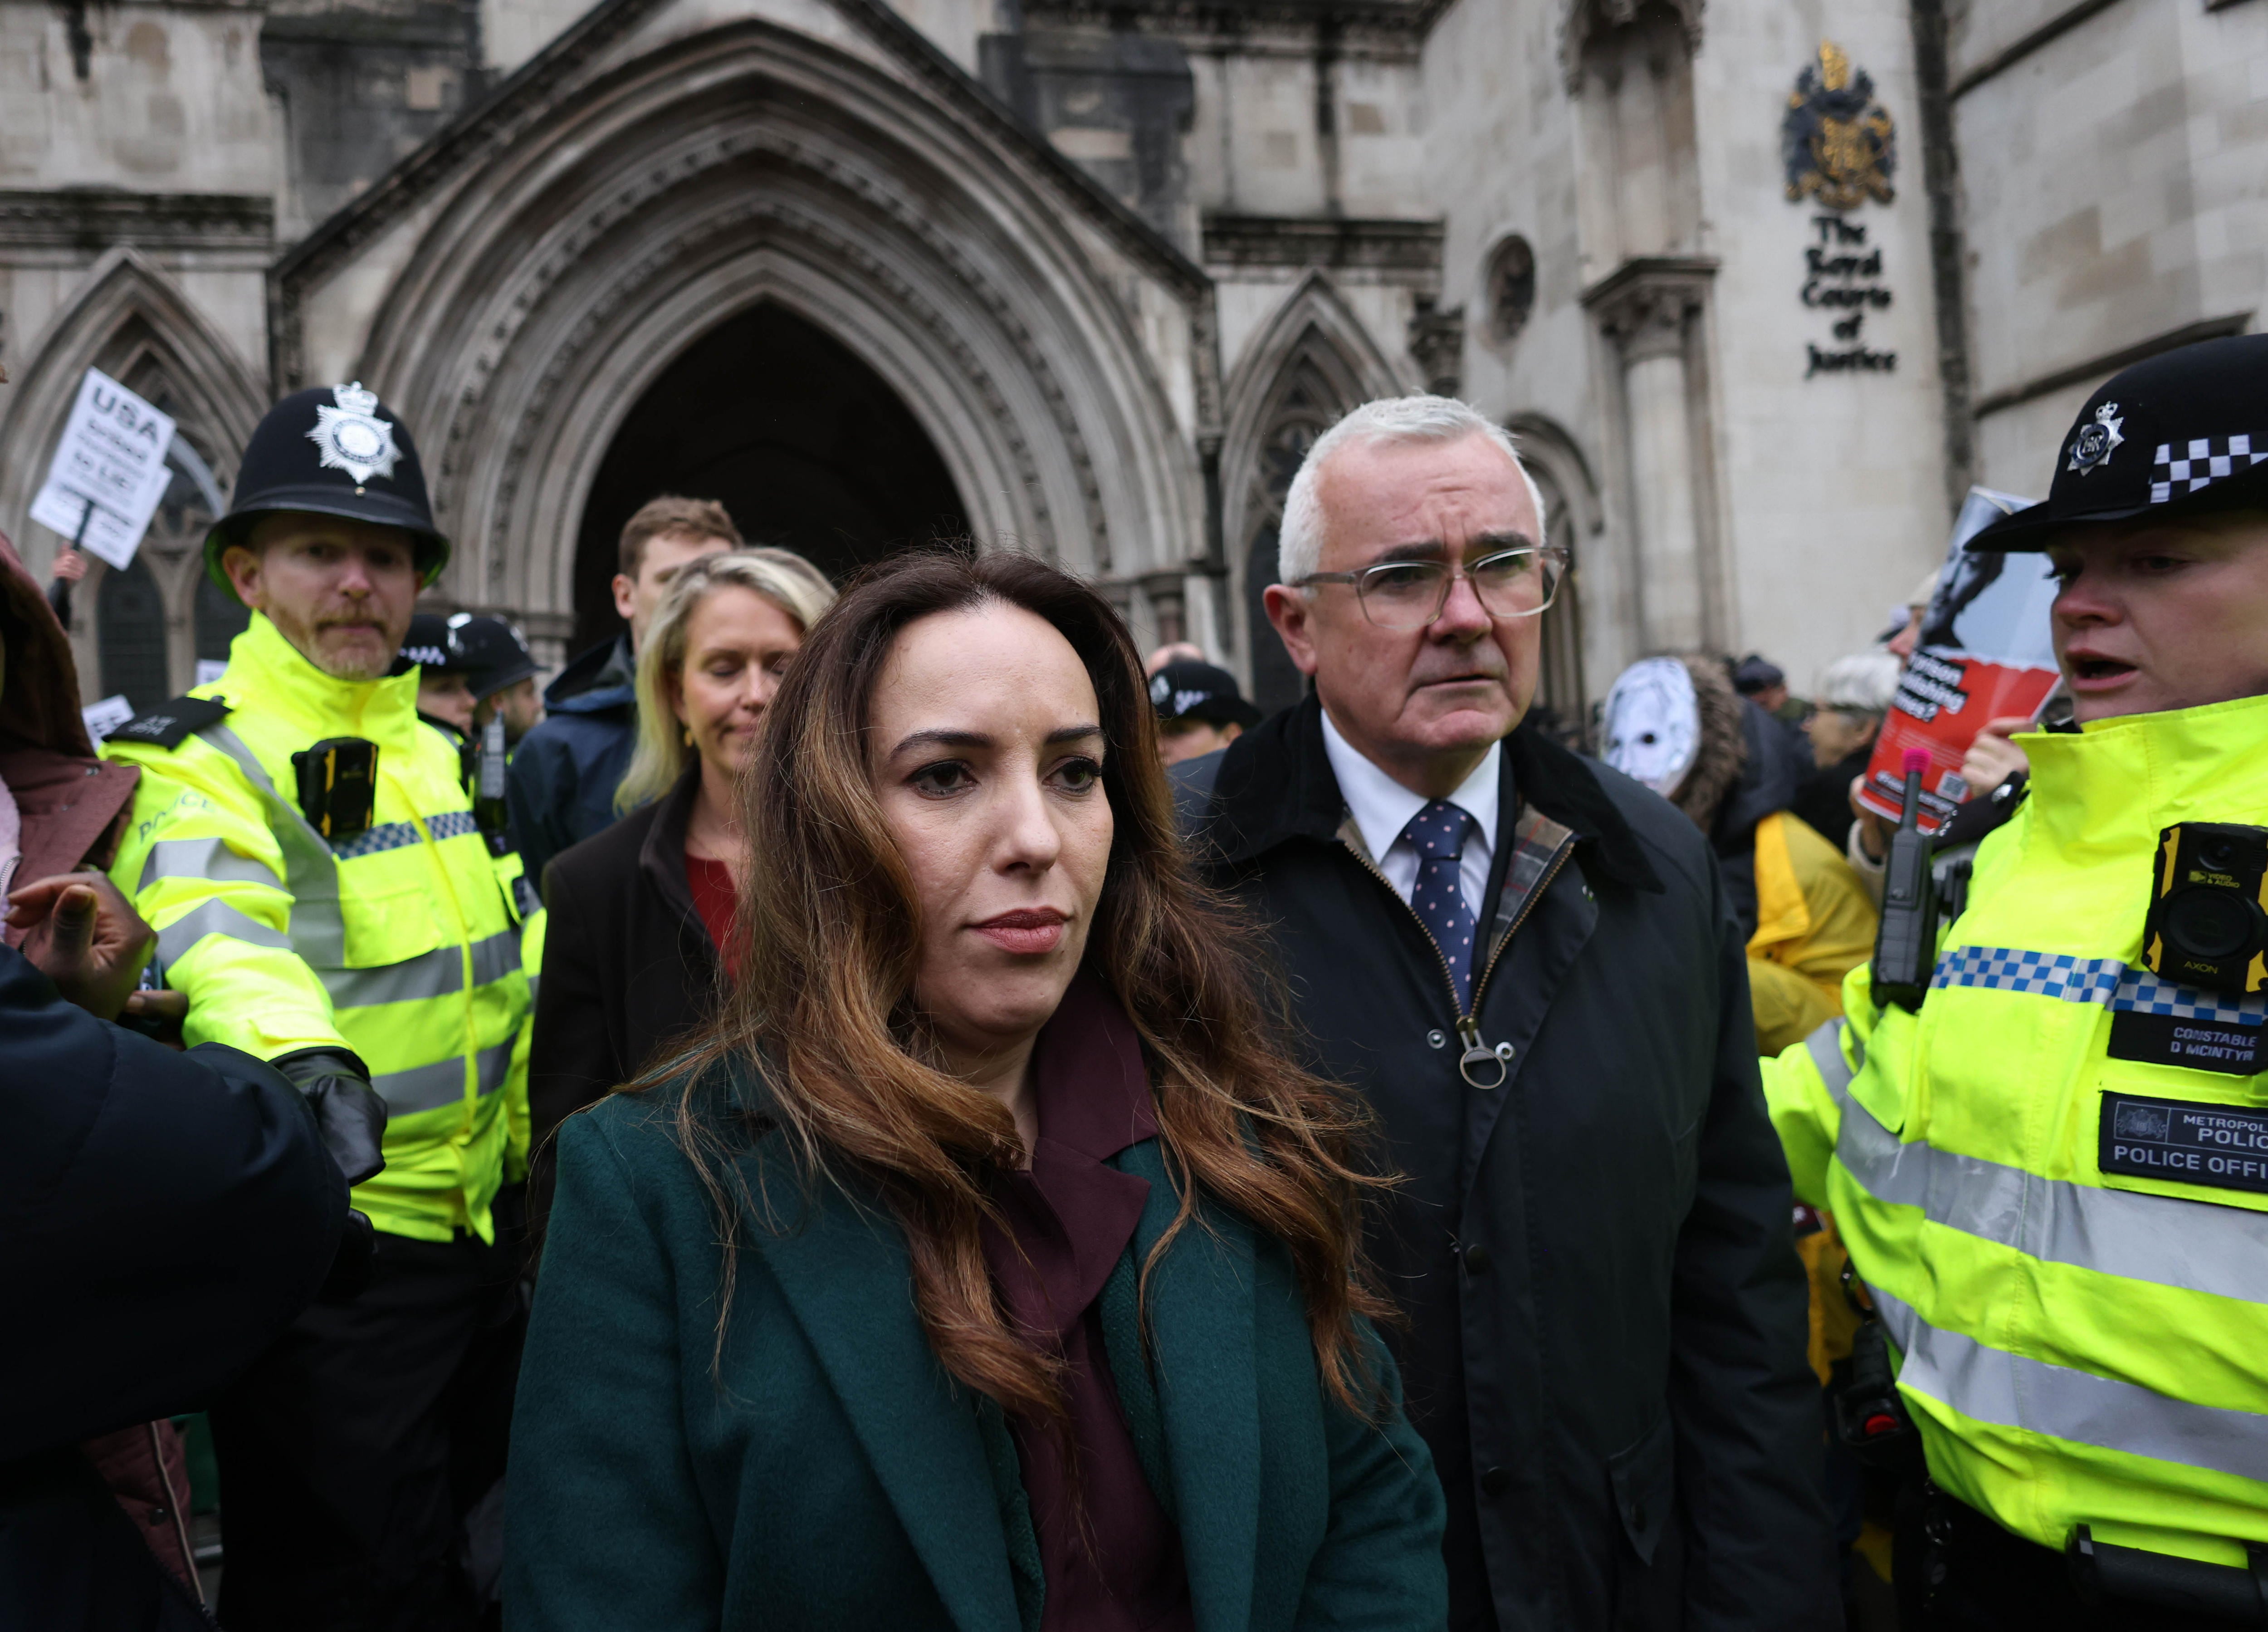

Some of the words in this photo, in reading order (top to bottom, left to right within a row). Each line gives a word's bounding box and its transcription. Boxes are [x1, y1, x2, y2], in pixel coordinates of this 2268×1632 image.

[1811, 216, 1865, 244] The
[1833, 314, 1863, 338] of
[1805, 343, 1897, 380] Justice
[93, 387, 158, 445] USA
[2208, 873, 2232, 881] VIDEO
[2214, 880, 2240, 888] AUDIO
[2184, 961, 2218, 974] AXON
[2170, 1041, 2181, 1053] D
[2174, 1027, 2257, 1047] CONSTABLE
[2114, 1145, 2200, 1170] POLICE
